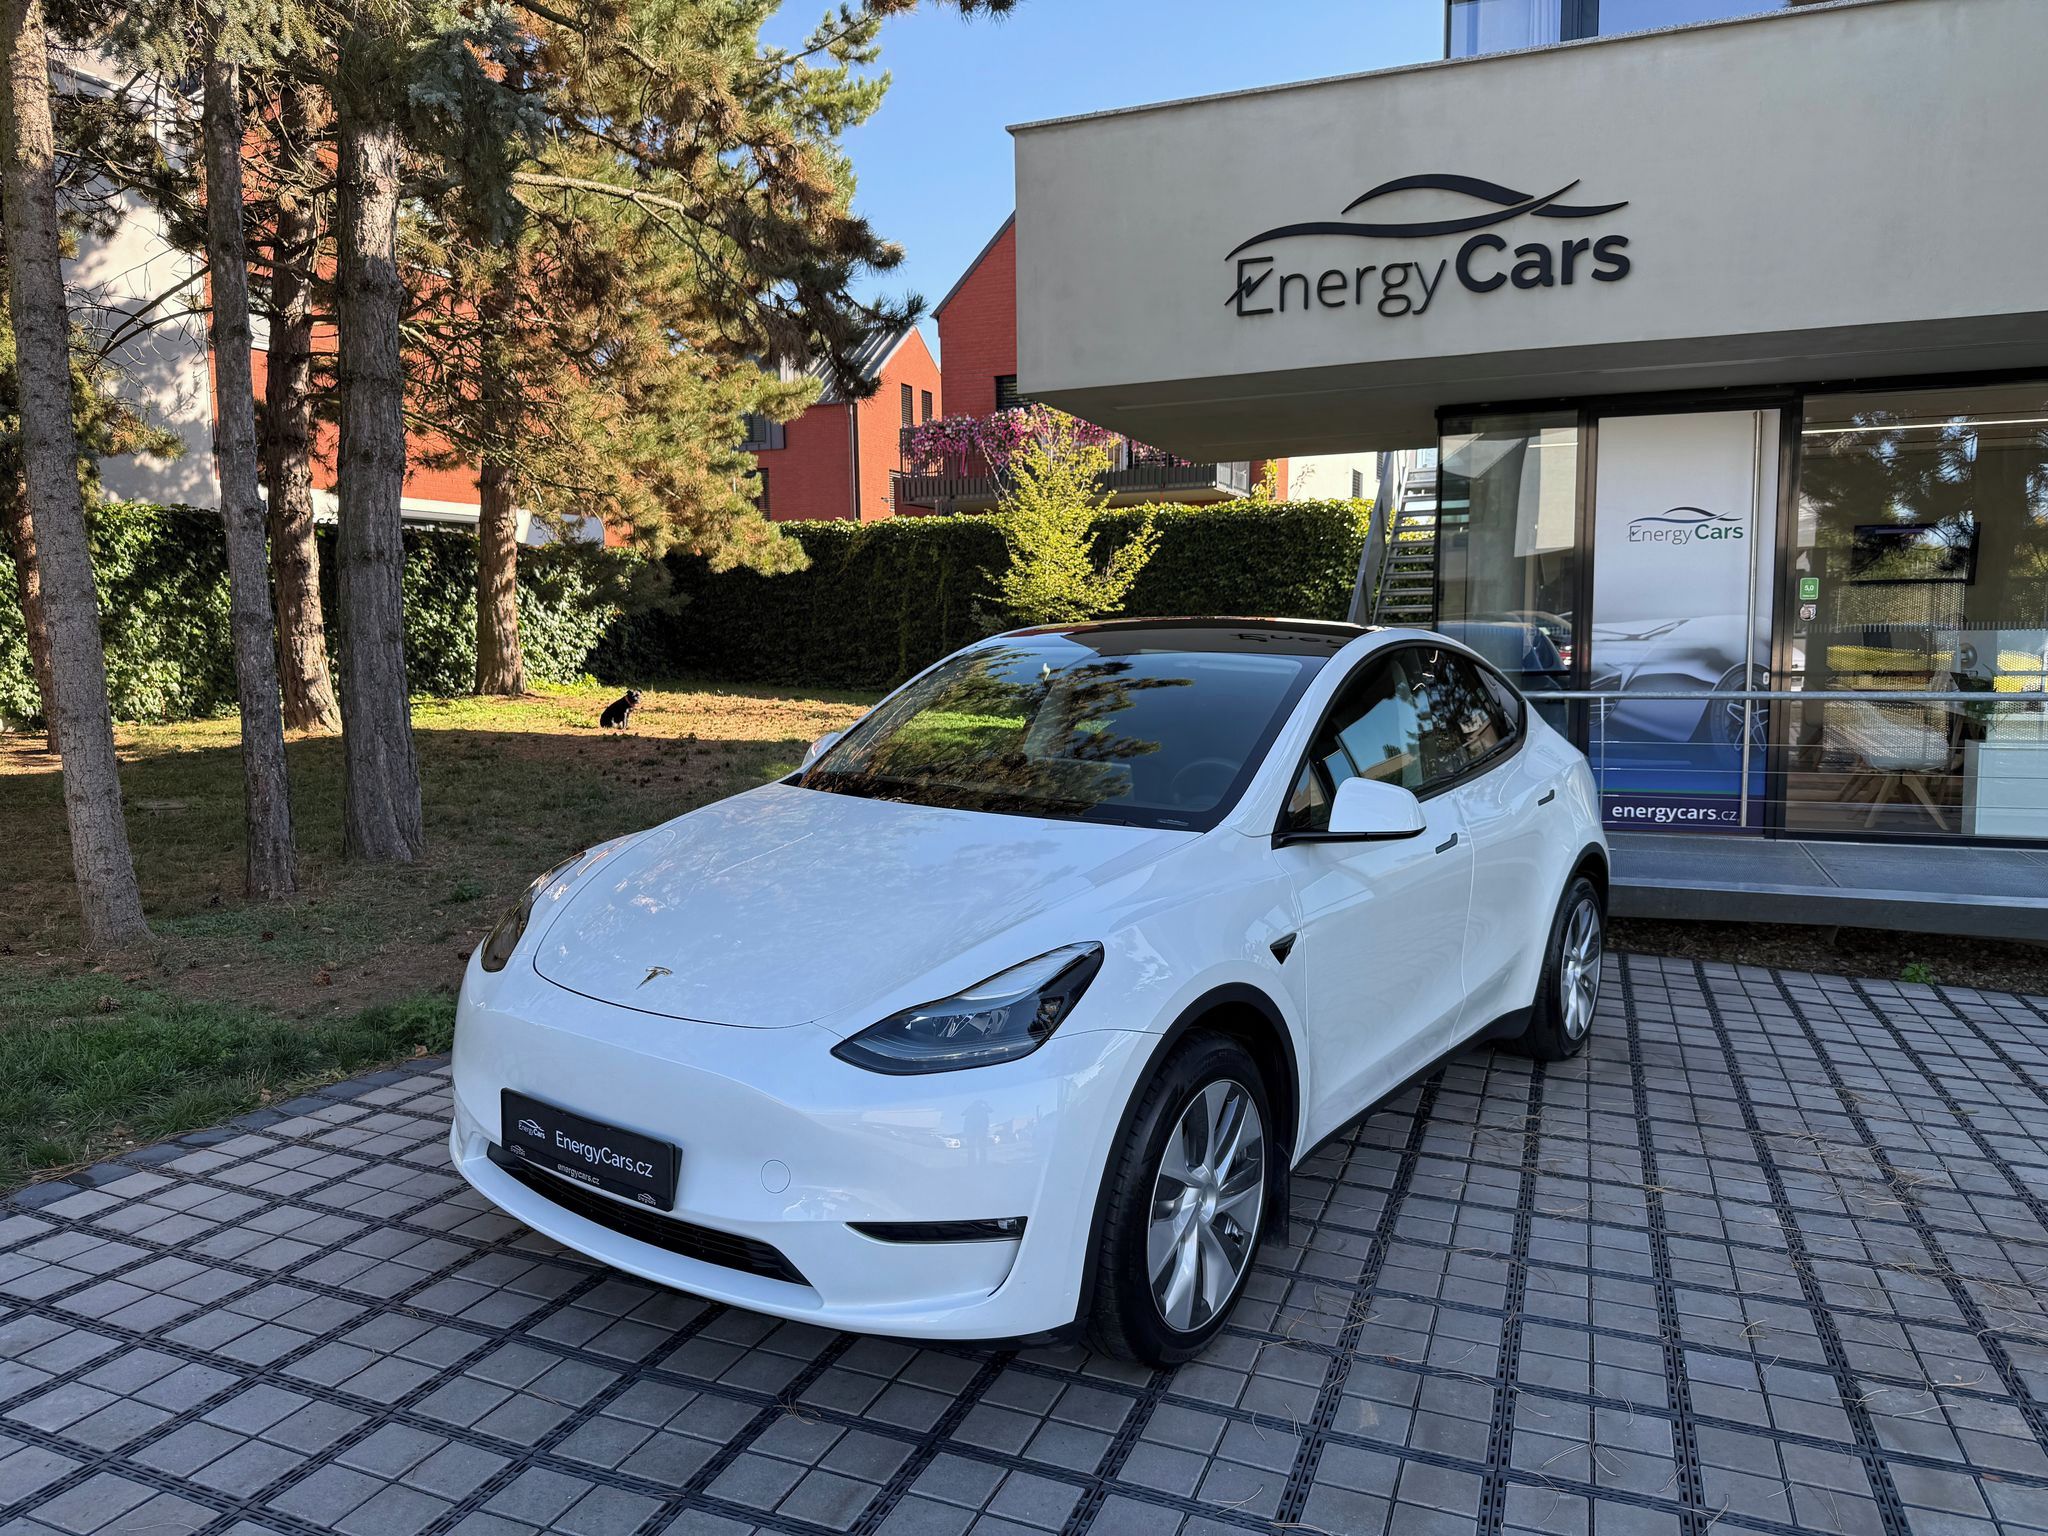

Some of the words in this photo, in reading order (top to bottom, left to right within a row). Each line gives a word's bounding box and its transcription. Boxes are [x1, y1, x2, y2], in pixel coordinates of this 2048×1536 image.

[1225, 233, 1632, 318] EnergyCars
[1627, 523, 1743, 545] EnergyCars
[1612, 805, 1737, 823] energycars.cz
[555, 1130, 653, 1178] EnergyCars.cz
[557, 1163, 600, 1185] energycars.cz
